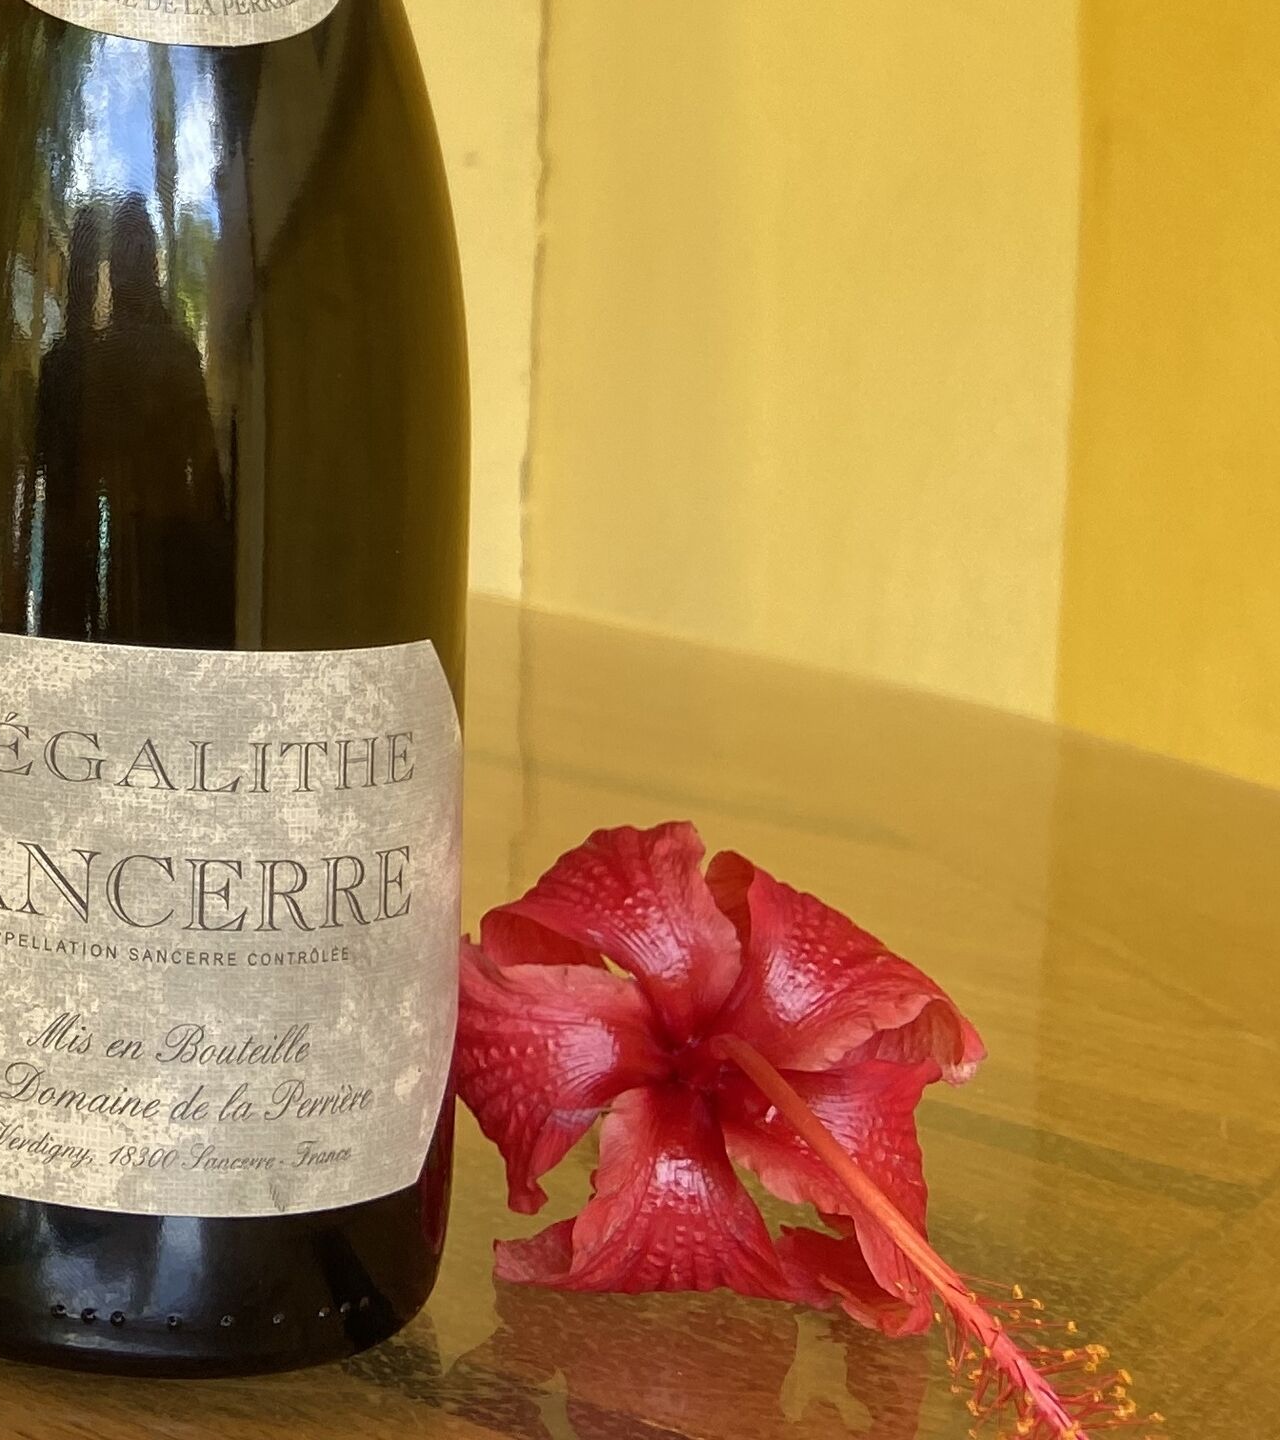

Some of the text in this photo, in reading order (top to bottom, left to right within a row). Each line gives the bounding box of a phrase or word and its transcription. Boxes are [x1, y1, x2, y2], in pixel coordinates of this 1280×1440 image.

[128, 947, 238, 967] SANCERRE
[246, 946, 351, 967] CONTRÔLÉE
[26, 1012, 311, 1065] Mis en Bouteille
[168, 1085, 210, 1122] de
[218, 1081, 257, 1122] la
[264, 1079, 373, 1121] Perrière
[108, 1146, 179, 1170] 18300
